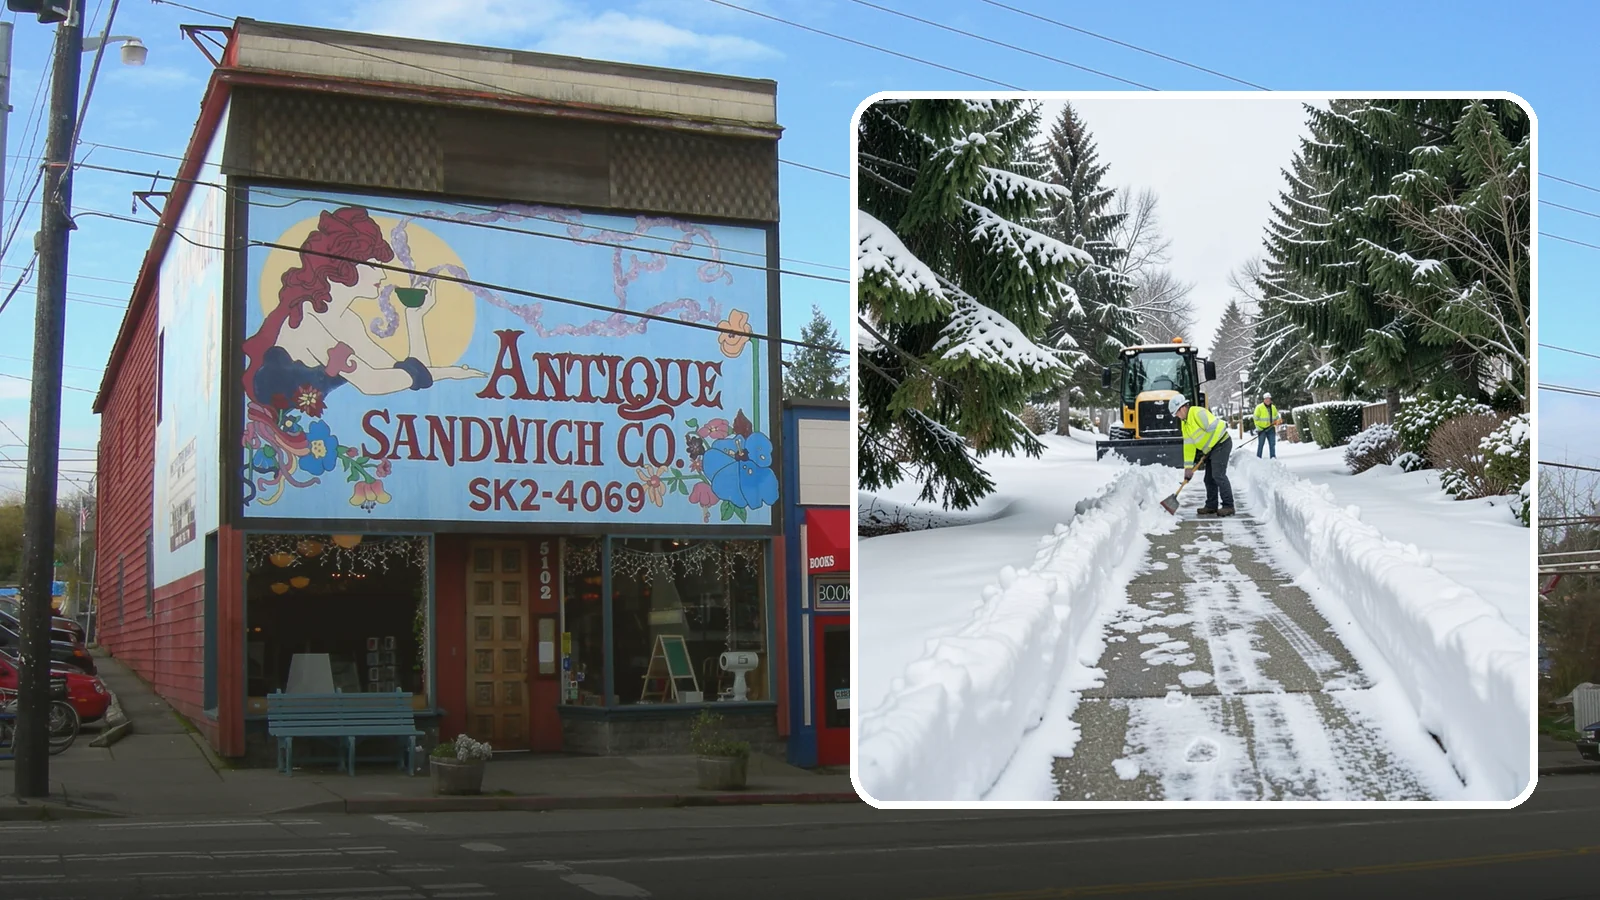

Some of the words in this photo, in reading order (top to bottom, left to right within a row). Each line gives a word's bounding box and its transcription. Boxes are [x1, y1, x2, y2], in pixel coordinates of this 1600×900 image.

[476, 329, 724, 421] ANTIQUE
[361, 408, 604, 467] SANDWICH
[616, 420, 685, 469] CO.
[468, 478, 646, 513] SK2-4069
[539, 541, 551, 600] 5102
[809, 555, 835, 569] BOOKS
